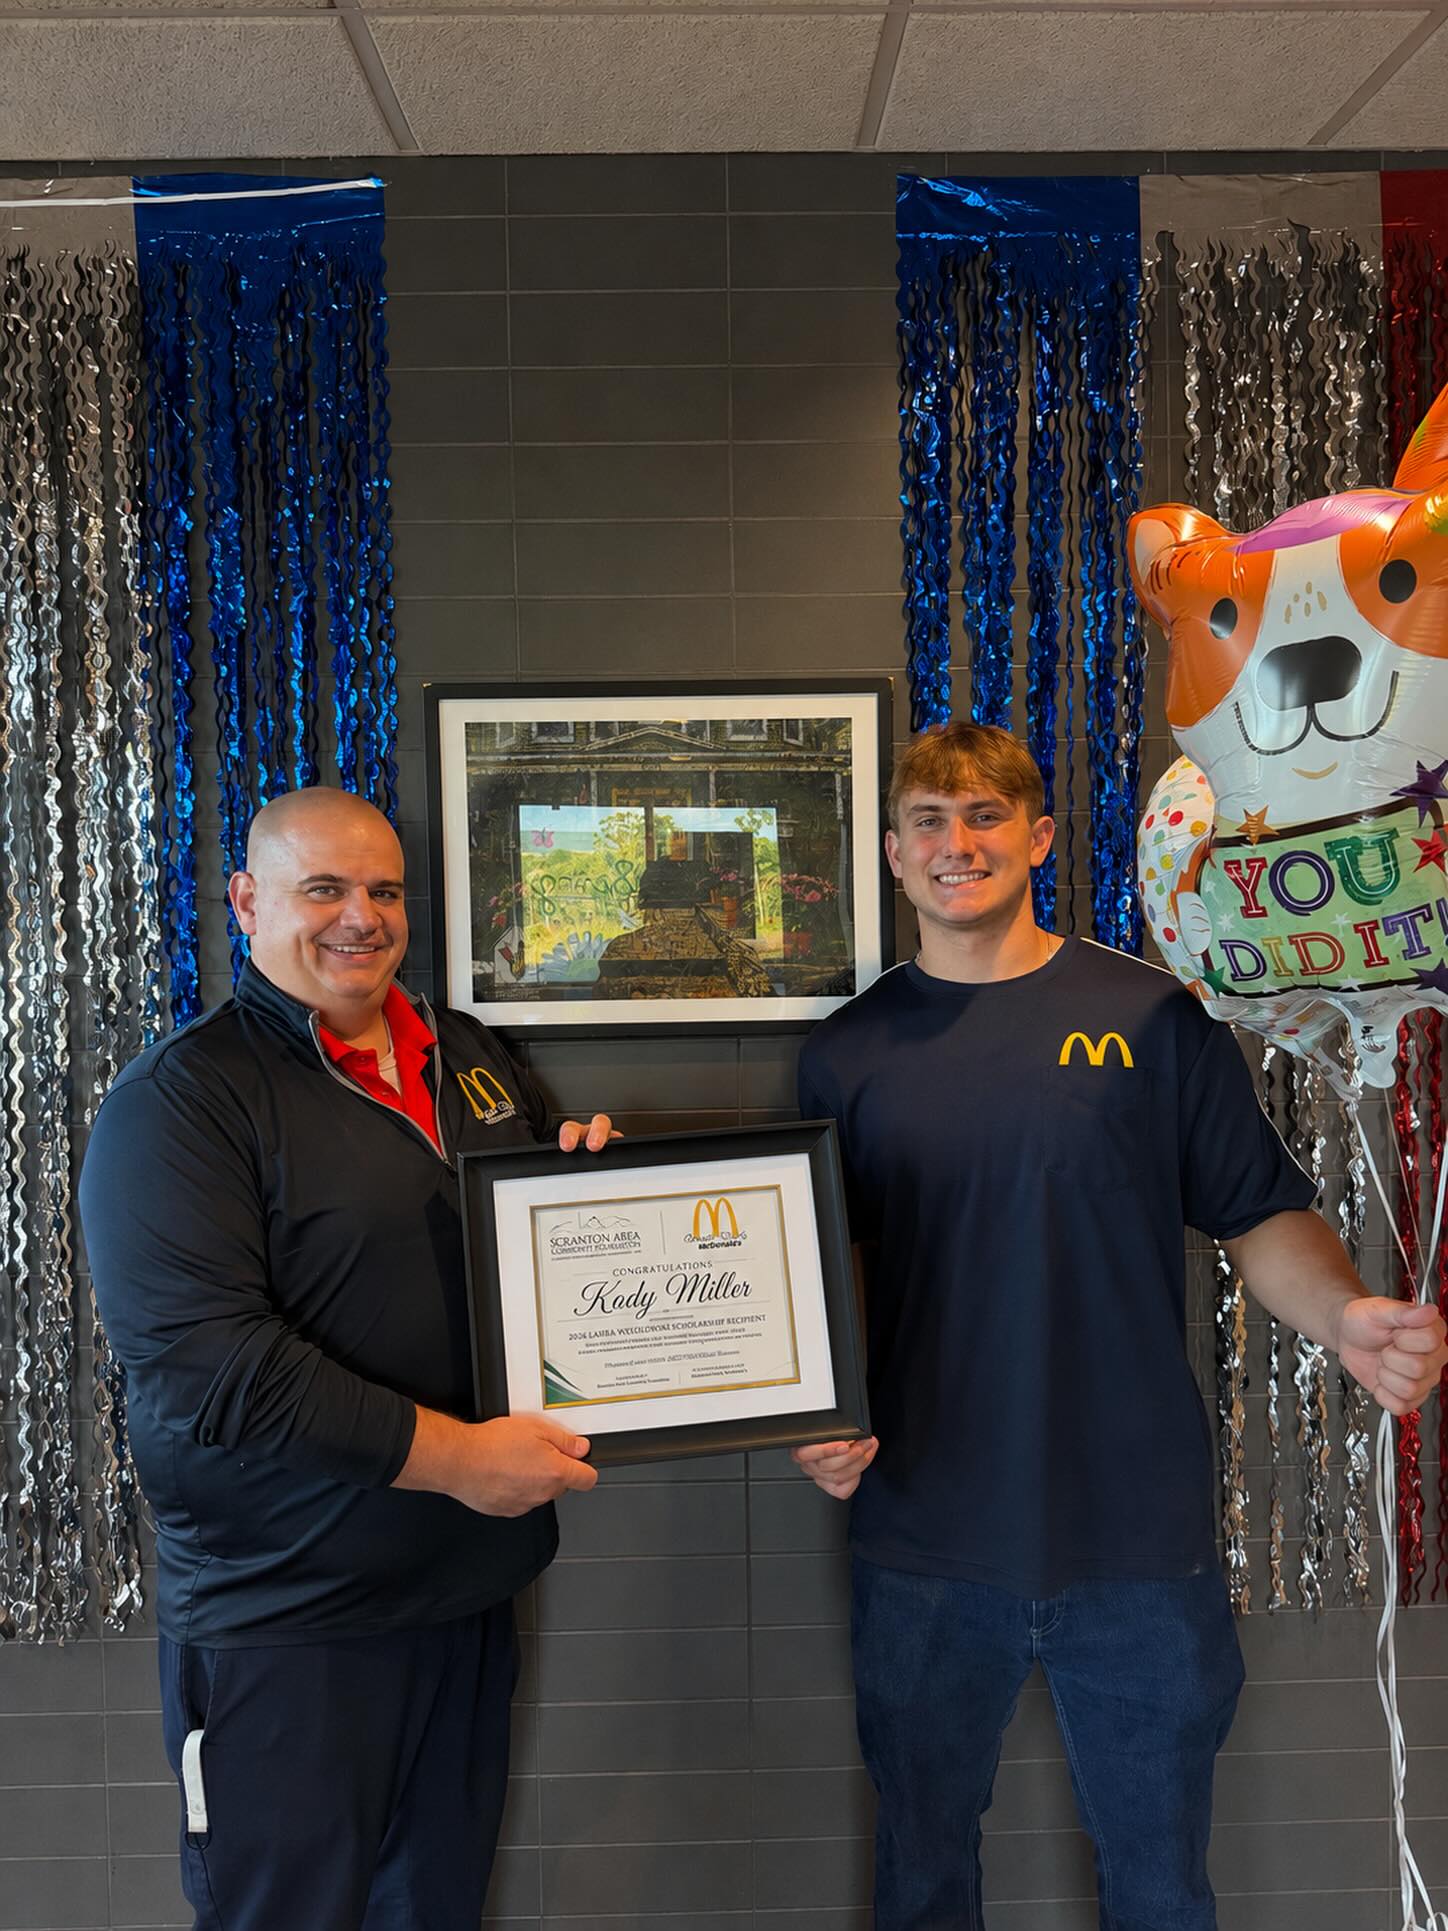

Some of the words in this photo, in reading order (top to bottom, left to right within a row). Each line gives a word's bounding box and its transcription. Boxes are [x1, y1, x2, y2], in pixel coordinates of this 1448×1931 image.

[1223, 827, 1401, 918] YOU
[1219, 931, 1346, 982] DID
[550, 1233, 610, 1248] SCRANTON
[612, 1260, 714, 1277] CONGRATULATIONS
[665, 1271, 753, 1304] Miller
[672, 1318, 725, 1331] SCHOLARSHIP
[726, 1314, 767, 1325] RECIPIENT
